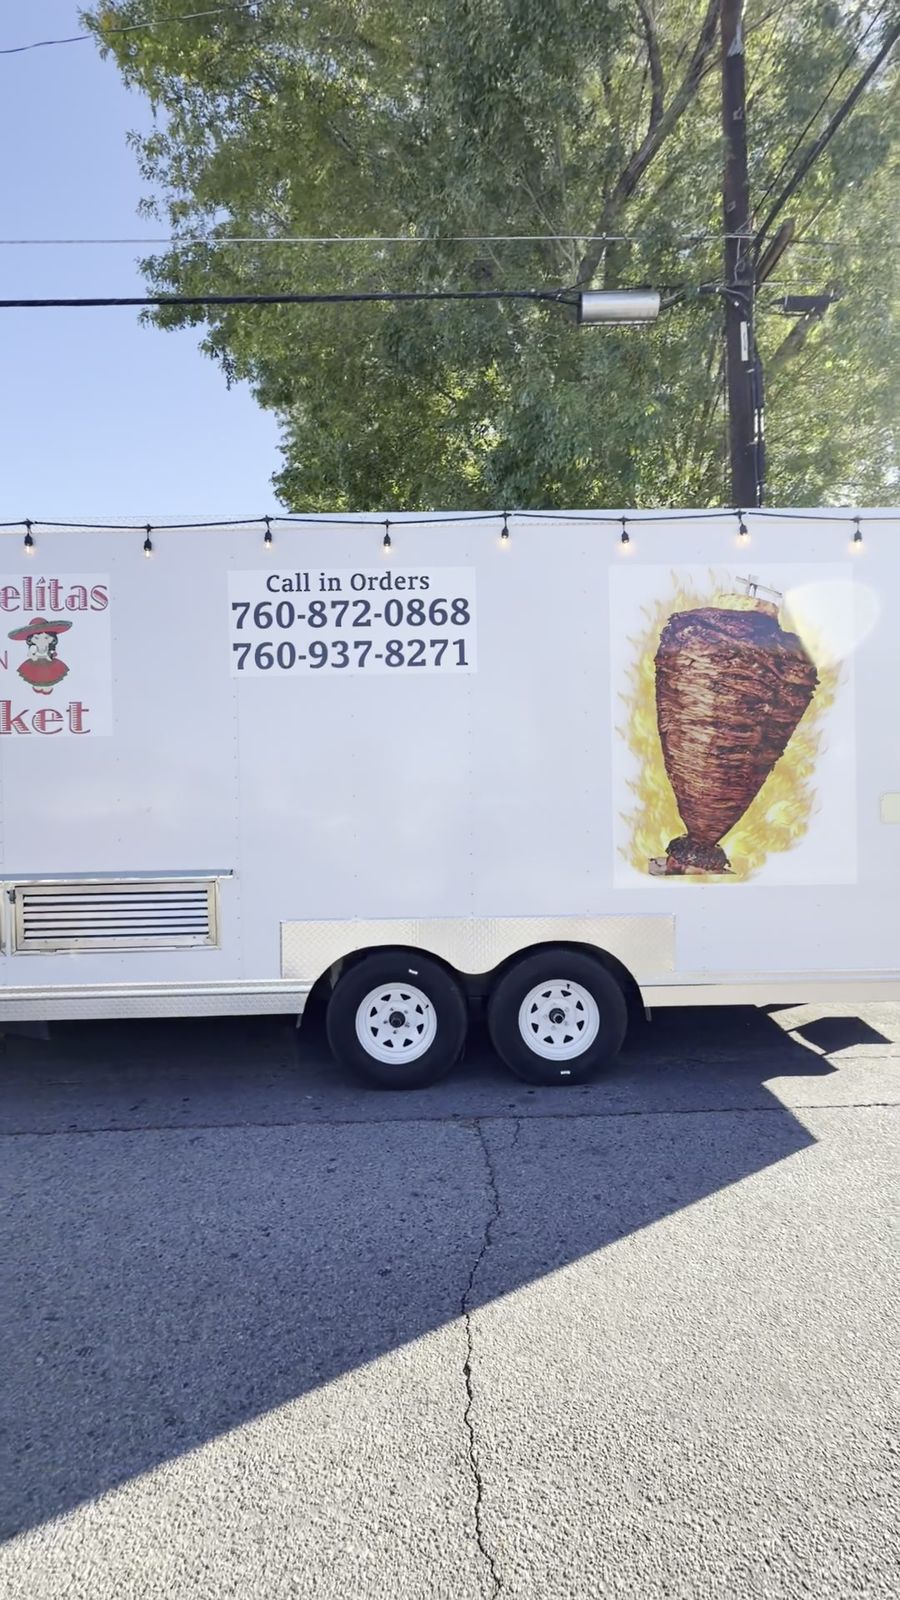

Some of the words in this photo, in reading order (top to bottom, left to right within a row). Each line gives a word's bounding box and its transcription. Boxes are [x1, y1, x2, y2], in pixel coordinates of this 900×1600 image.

[266, 573, 311, 592] Call
[319, 572, 342, 591] in
[350, 571, 430, 591] Orders
[231, 598, 471, 629] 760-872-0868
[232, 639, 469, 670] 760-937-8271
